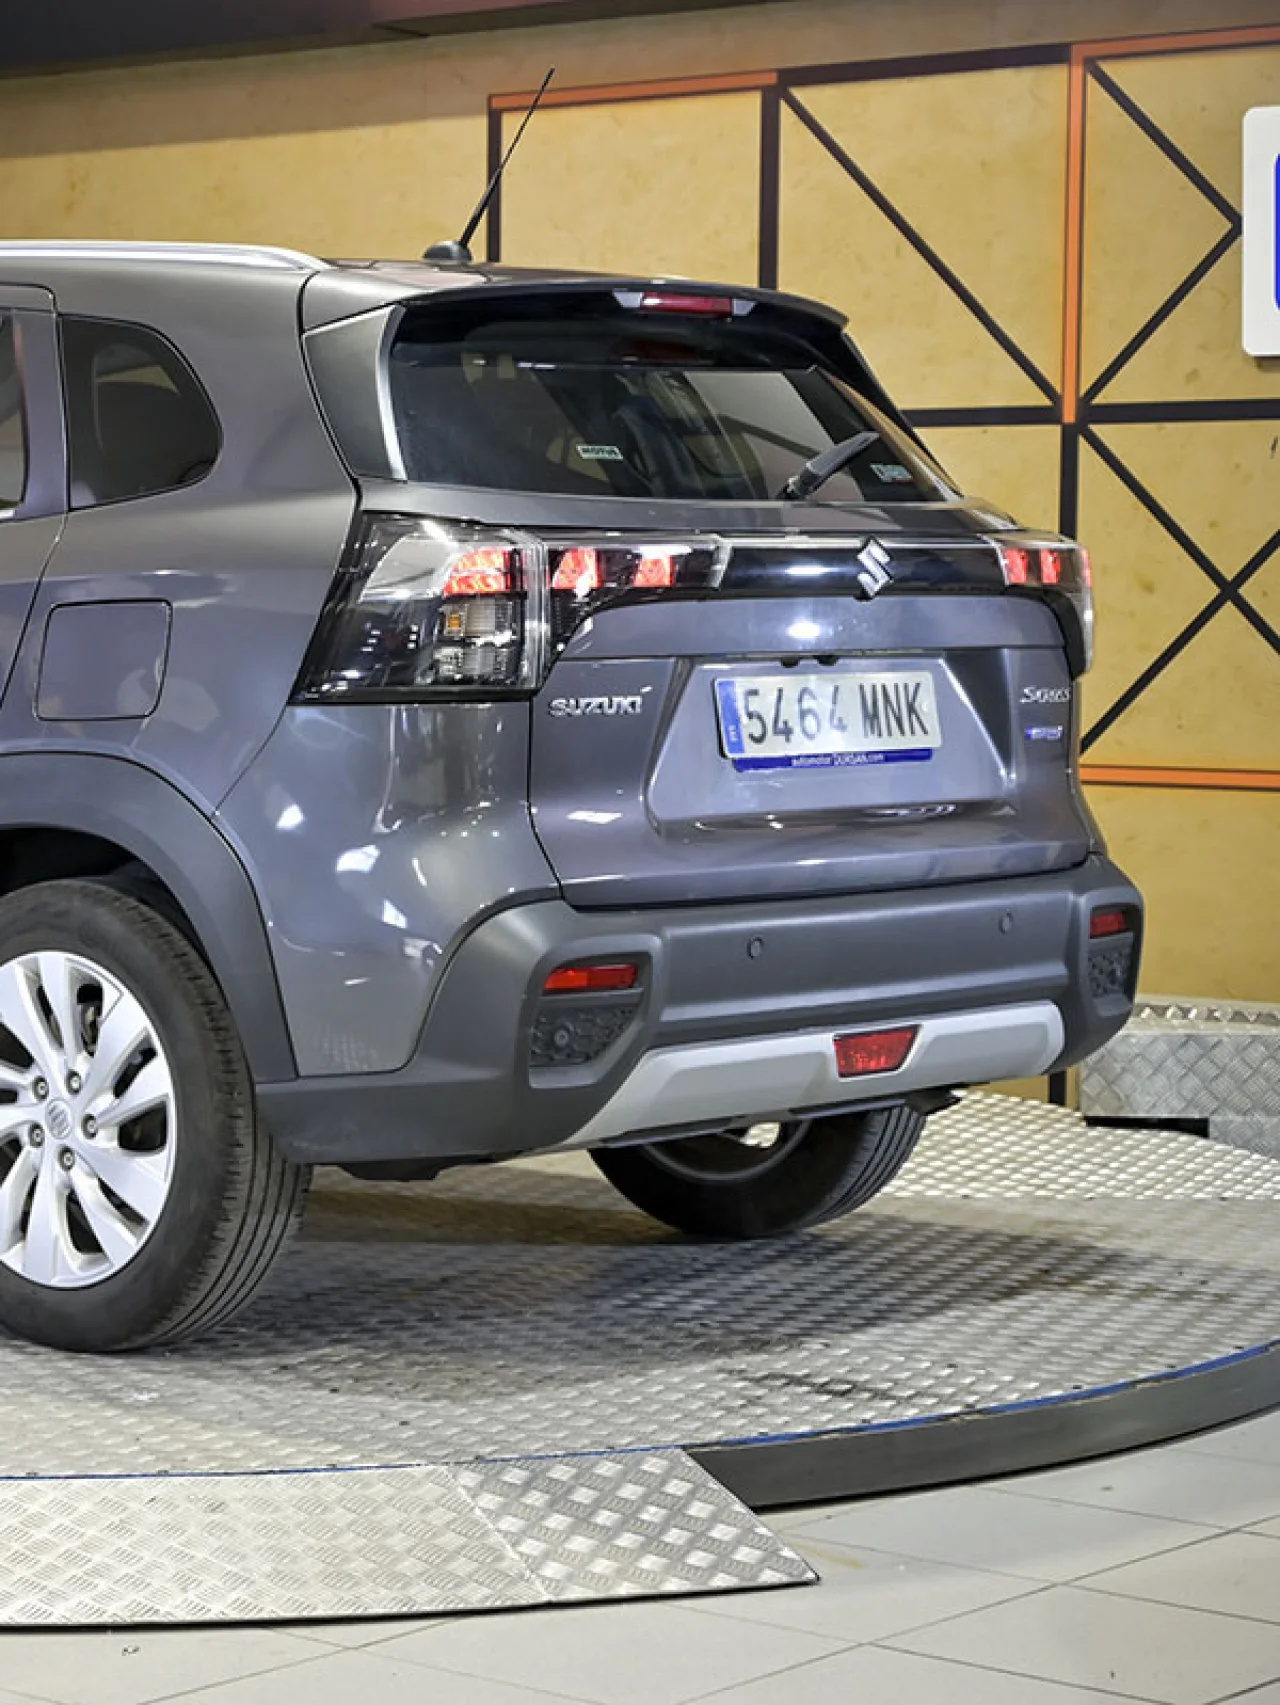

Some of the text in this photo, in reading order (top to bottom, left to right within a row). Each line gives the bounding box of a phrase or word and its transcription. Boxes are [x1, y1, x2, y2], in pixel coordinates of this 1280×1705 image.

[549, 695, 643, 717] SUZUKI
[743, 682, 929, 744] 5464 MNK
